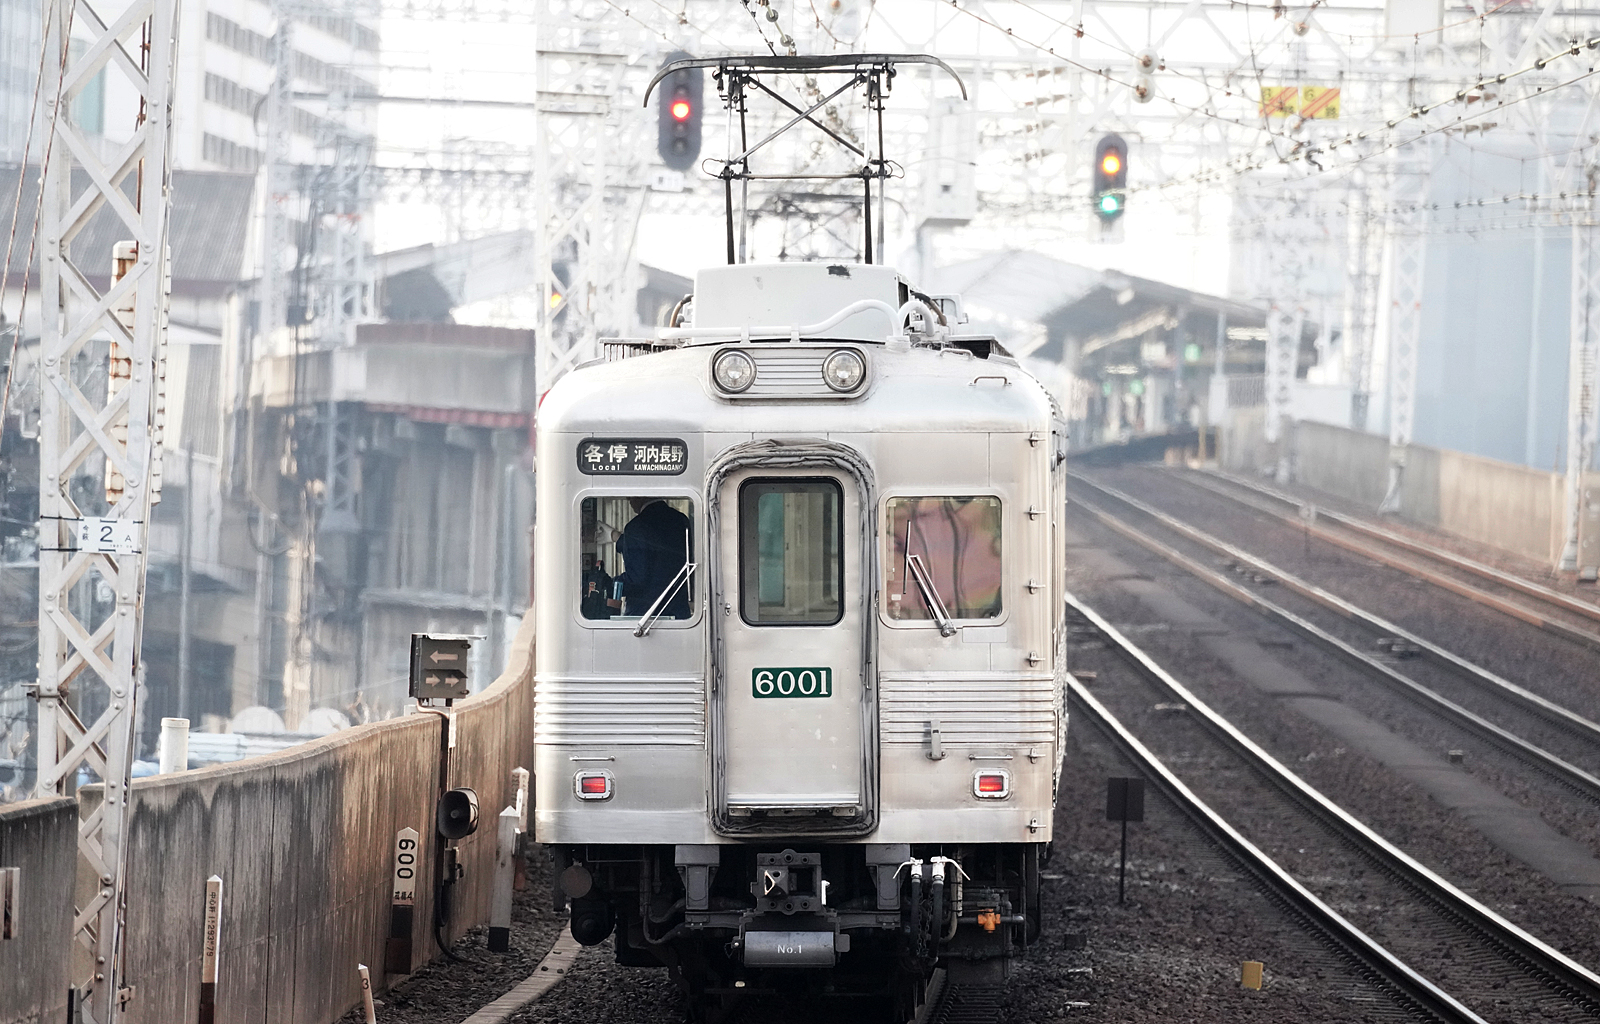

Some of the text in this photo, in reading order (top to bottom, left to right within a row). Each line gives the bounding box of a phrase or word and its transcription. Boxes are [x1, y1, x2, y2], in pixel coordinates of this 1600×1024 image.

[584, 444, 684, 463] 各停 河内長野
[100, 526, 113, 543] 2
[755, 670, 828, 695] 6001
[397, 839, 416, 879] 600
[777, 944, 802, 954] No.1
[362, 978, 369, 990] 3
